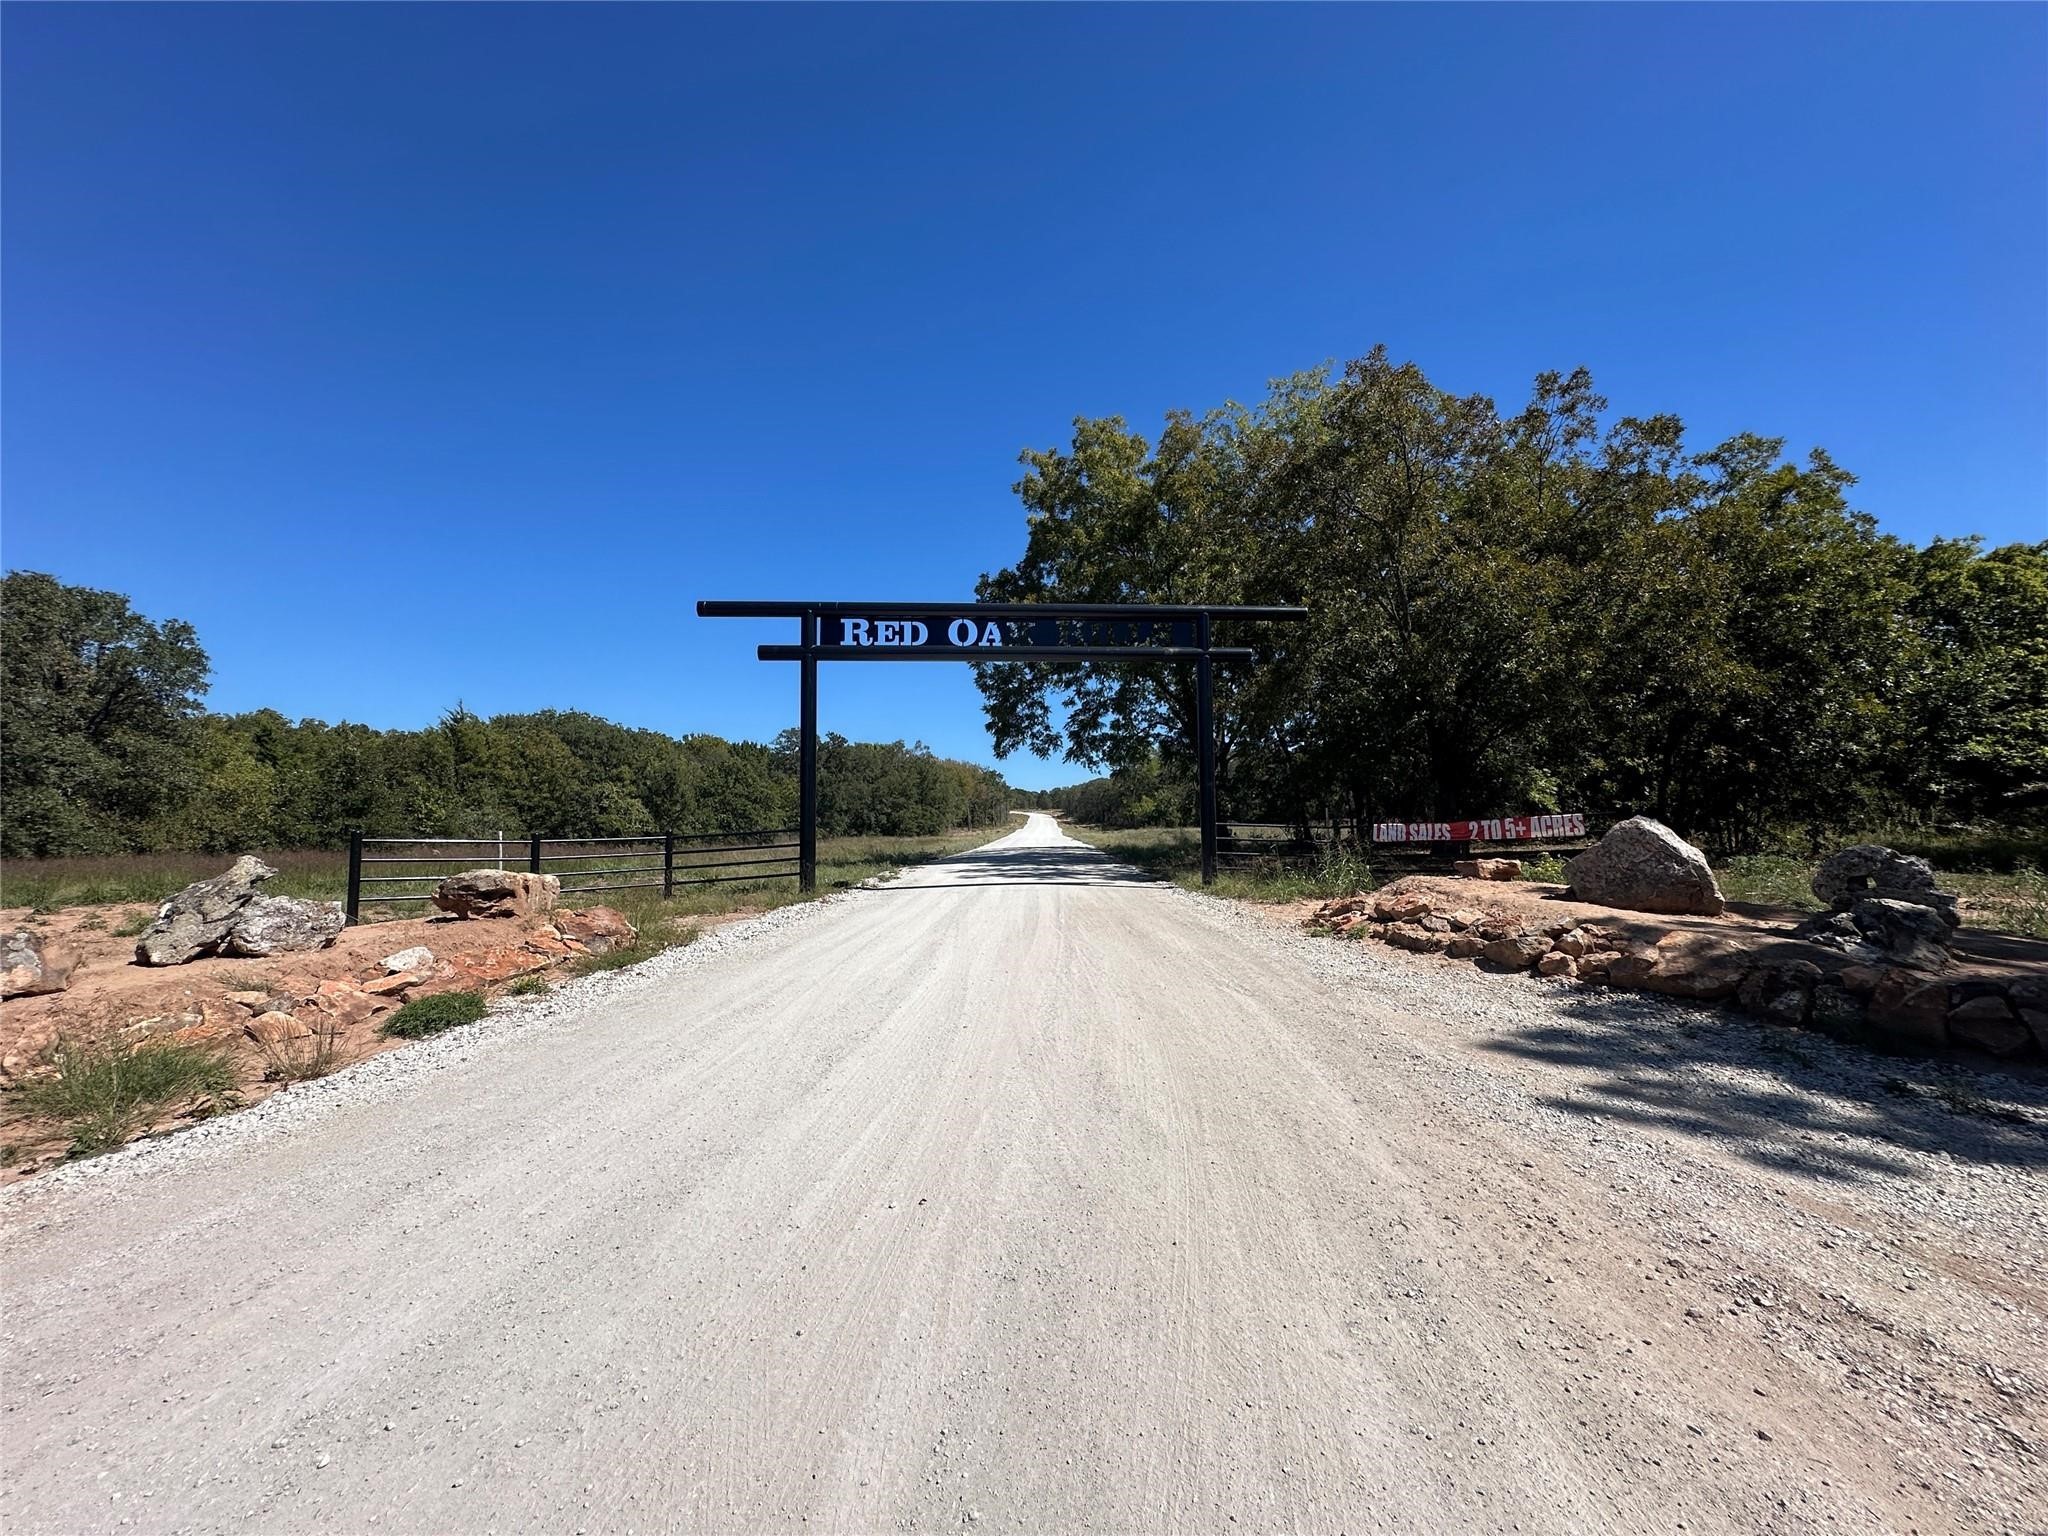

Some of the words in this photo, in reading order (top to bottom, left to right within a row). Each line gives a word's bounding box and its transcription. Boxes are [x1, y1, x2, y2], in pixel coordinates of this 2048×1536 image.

[840, 618, 928, 647] RED
[1373, 824, 1406, 842] LAND
[1409, 823, 1451, 841] SALES
[1469, 821, 1478, 840] 2
[1480, 820, 1501, 840] TO
[1505, 818, 1526, 839] 5+
[1530, 813, 1585, 838] ACRES
